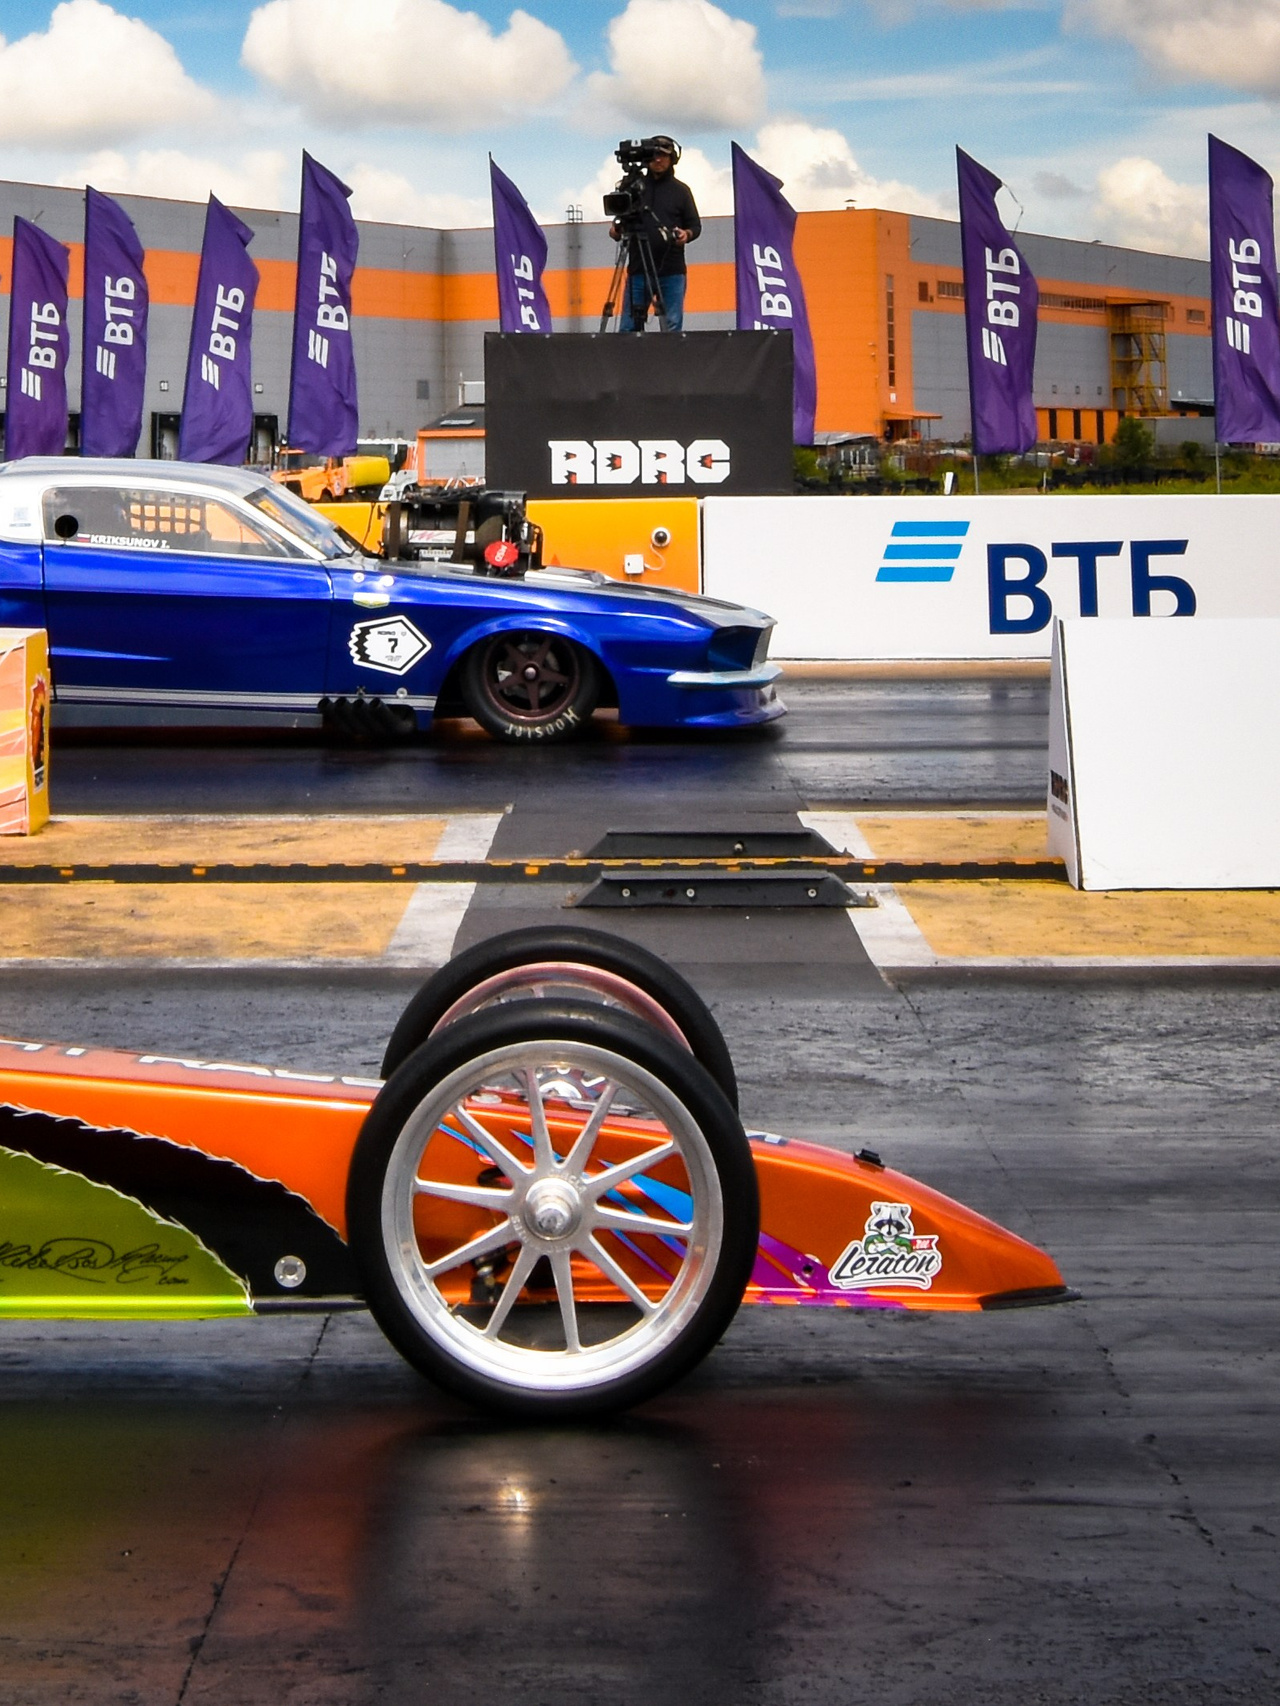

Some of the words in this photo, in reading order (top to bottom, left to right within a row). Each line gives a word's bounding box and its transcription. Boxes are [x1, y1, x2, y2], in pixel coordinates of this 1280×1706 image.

[105, 276, 135, 346] ВТБ
[317, 251, 350, 331] ВТБ
[753, 244, 793, 318] ВТБ
[985, 247, 1021, 328] ВТБ
[1228, 238, 1263, 319] ВТБ
[28, 301, 61, 370] ВТБ
[208, 284, 245, 361] ВТБ
[548, 439, 731, 485] RDRC
[987, 540, 1197, 635] ВТБ
[388, 638, 398, 653] 7
